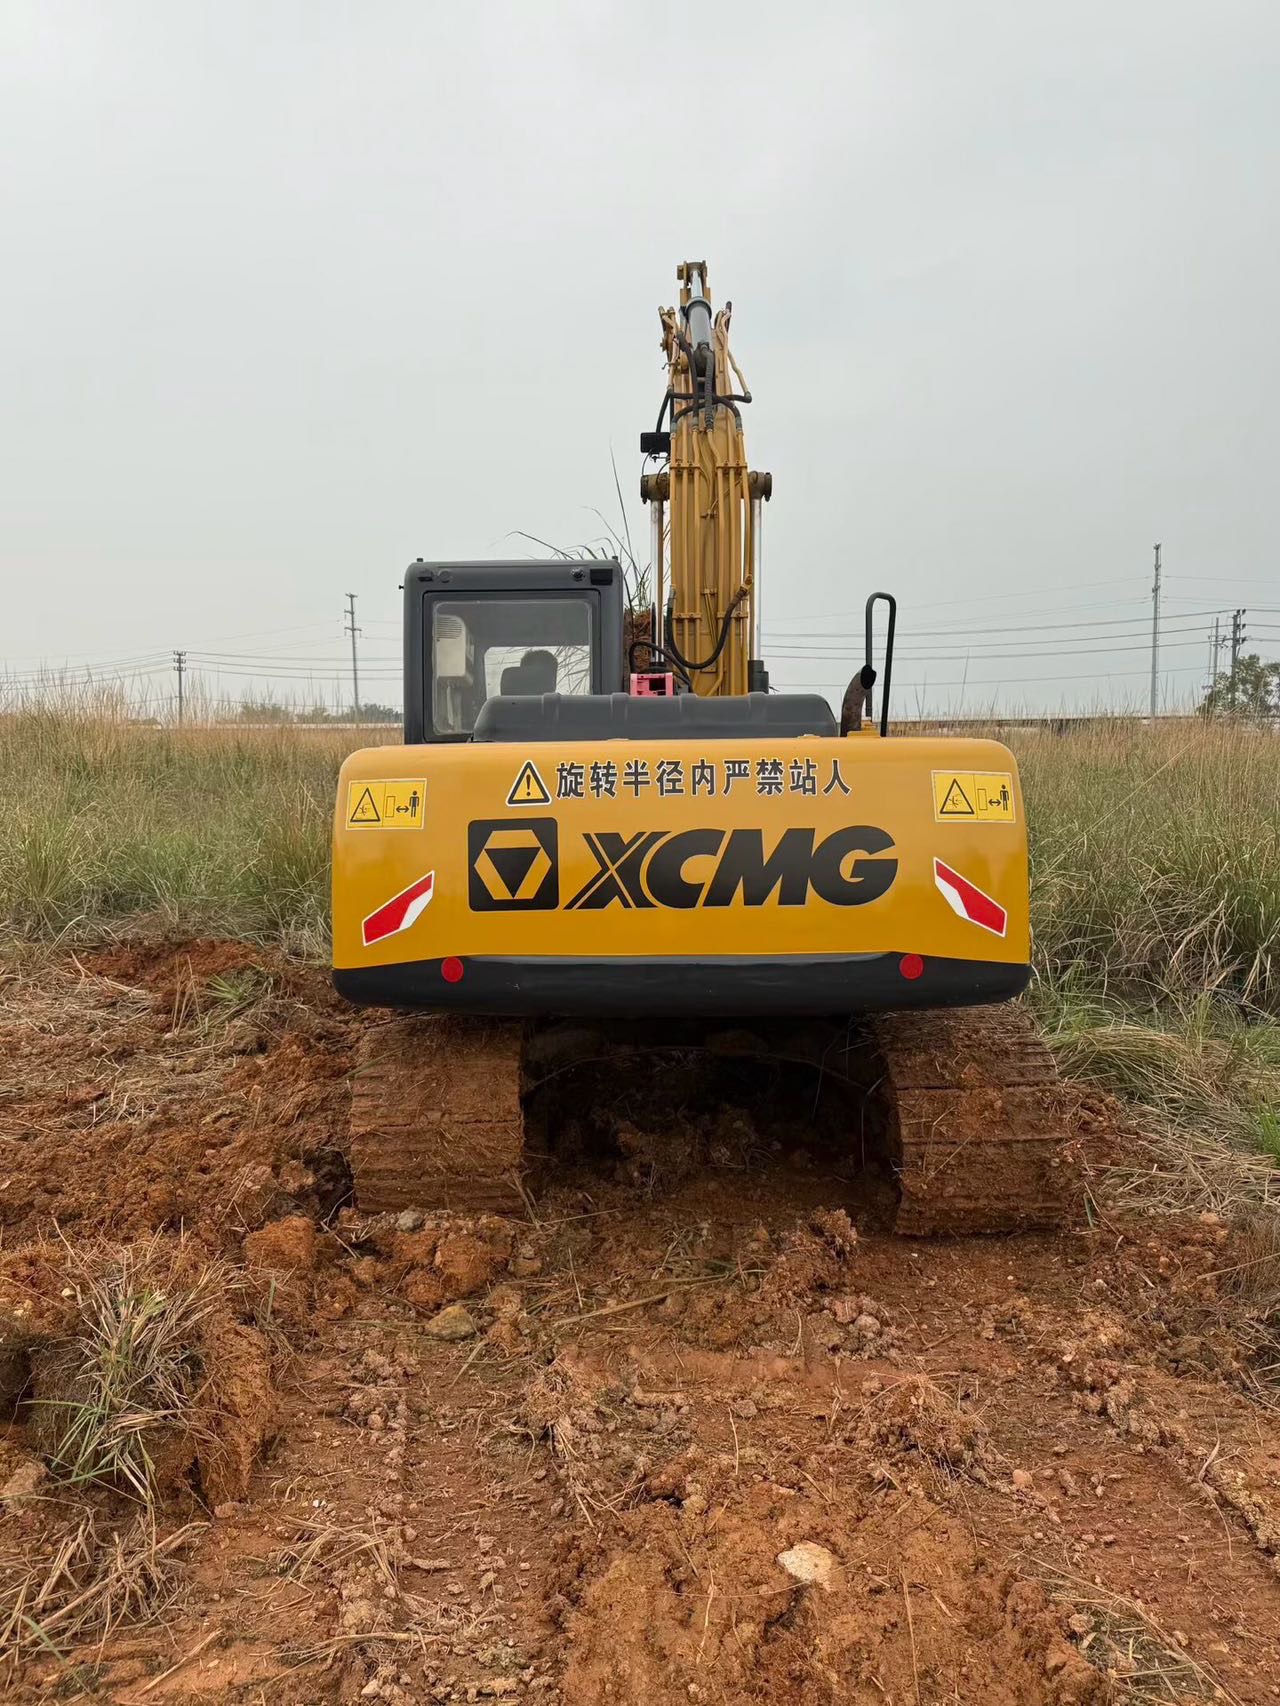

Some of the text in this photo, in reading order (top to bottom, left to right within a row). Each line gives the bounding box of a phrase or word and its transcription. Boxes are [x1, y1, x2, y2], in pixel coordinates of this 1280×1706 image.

[556, 758, 851, 798] 旋转半径内严禁站人
[563, 825, 898, 910] XCMG
